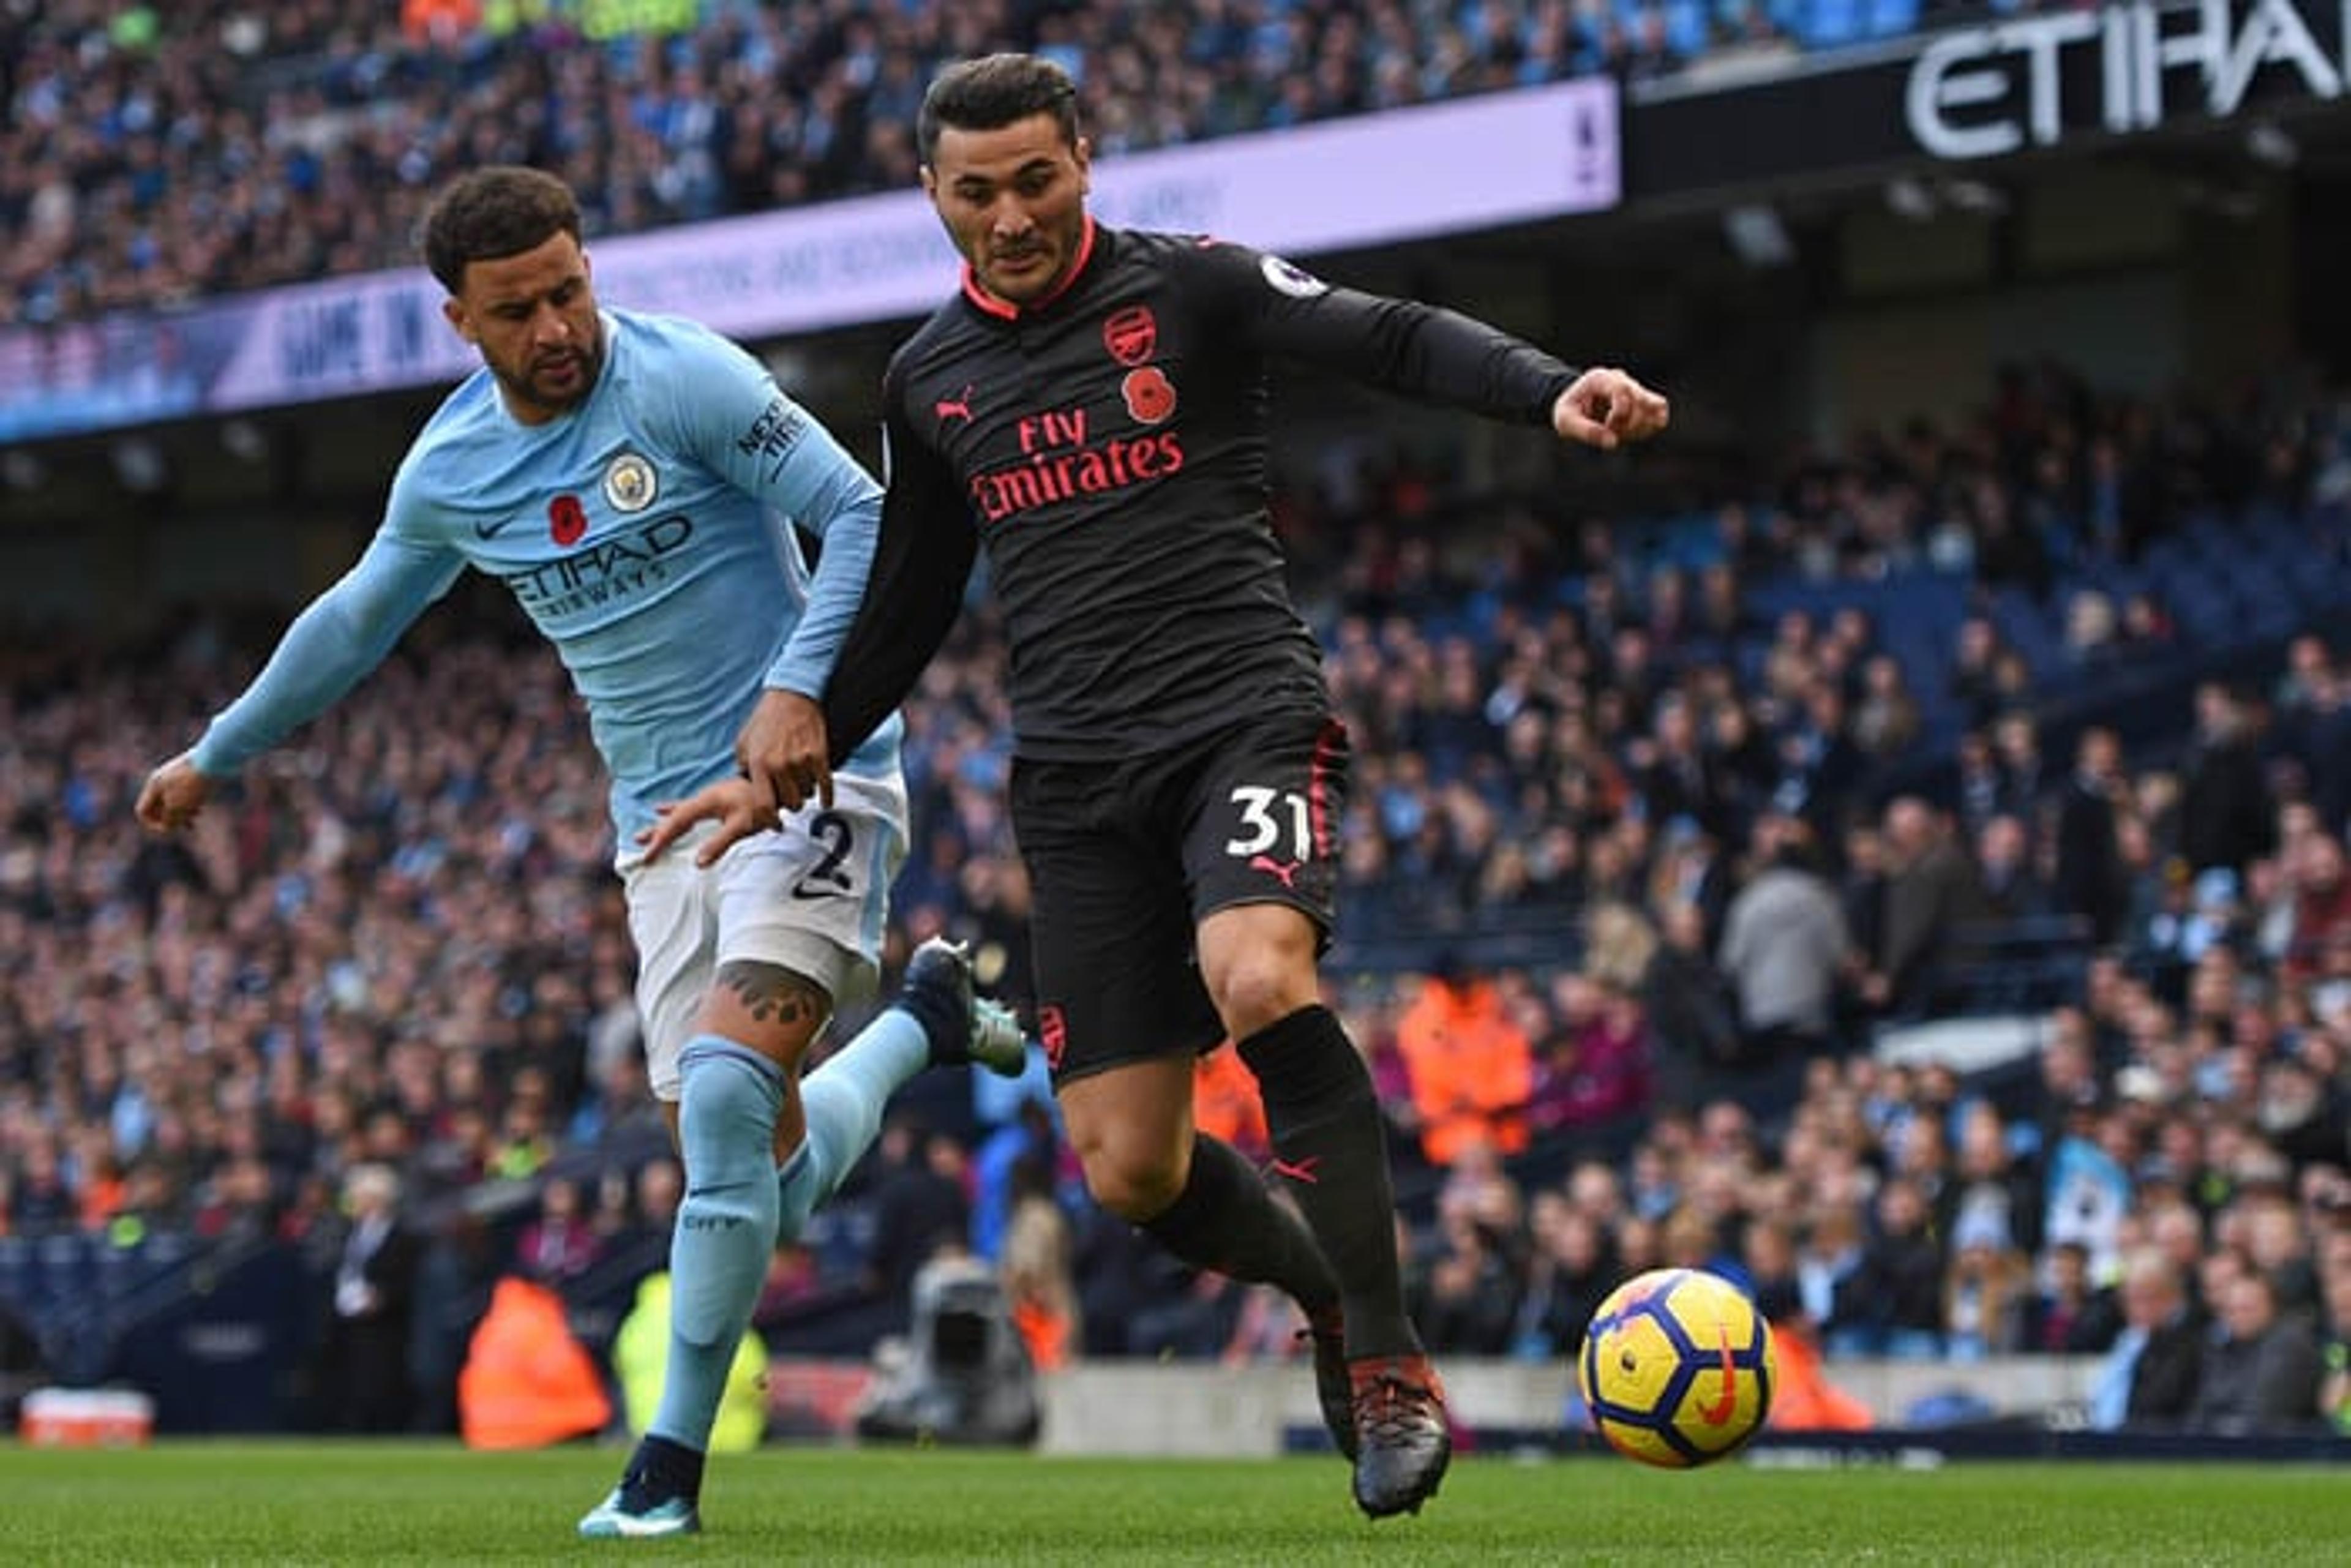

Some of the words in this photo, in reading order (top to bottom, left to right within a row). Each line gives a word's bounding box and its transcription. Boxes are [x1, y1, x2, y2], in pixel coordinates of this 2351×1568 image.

[1905, 0, 2351, 160] ETIHA
[1018, 408, 1088, 454] Fly
[970, 432, 1184, 520] Emirates
[808, 809, 853, 891] 2
[1226, 786, 1310, 863] 31
